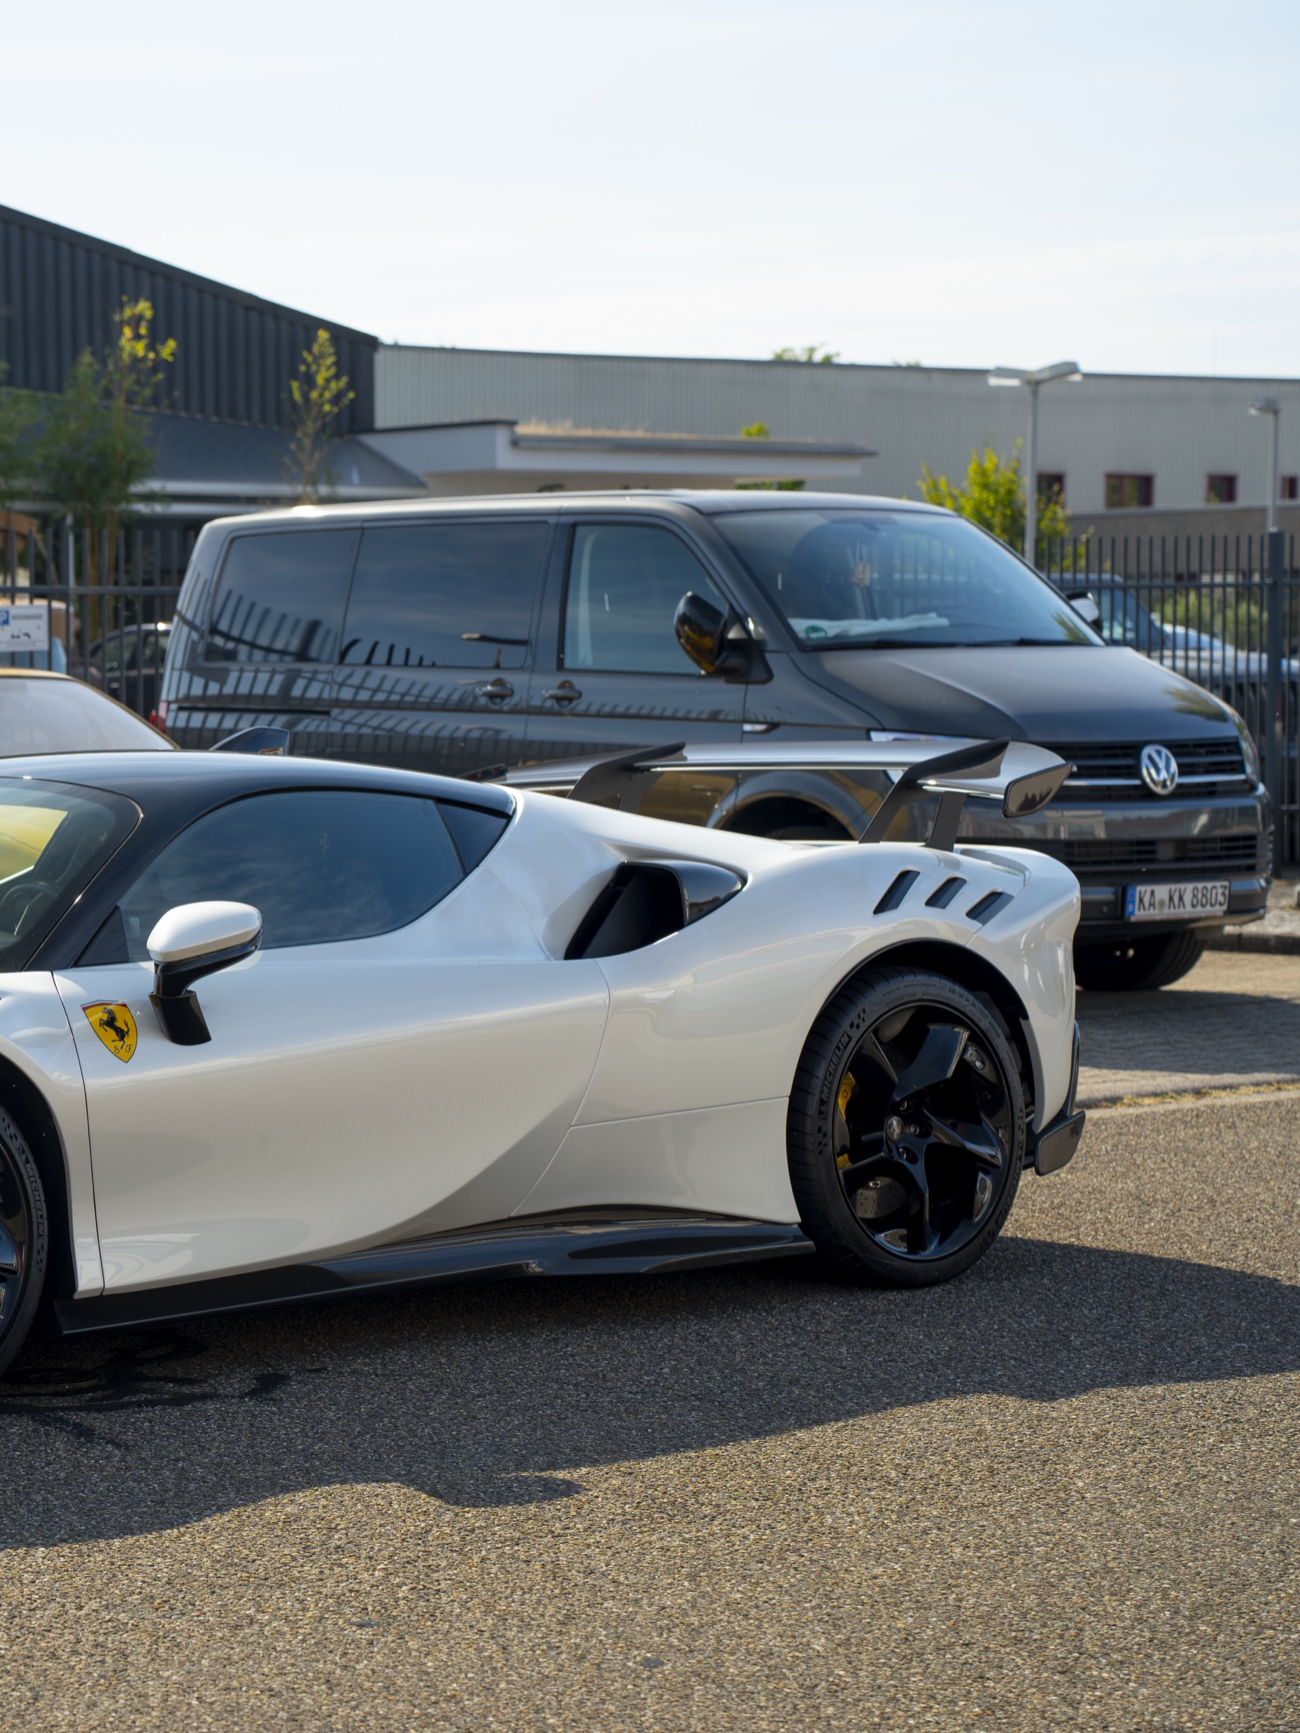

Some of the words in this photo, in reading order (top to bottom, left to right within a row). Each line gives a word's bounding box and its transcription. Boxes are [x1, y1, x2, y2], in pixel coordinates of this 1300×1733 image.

[1137, 888, 1156, 912] KA
[1168, 886, 1187, 910] KK
[1191, 884, 1228, 909] 8803
[821, 1031, 852, 1103] MICHELIN
[25, 1162, 45, 1237] MICHELIN
